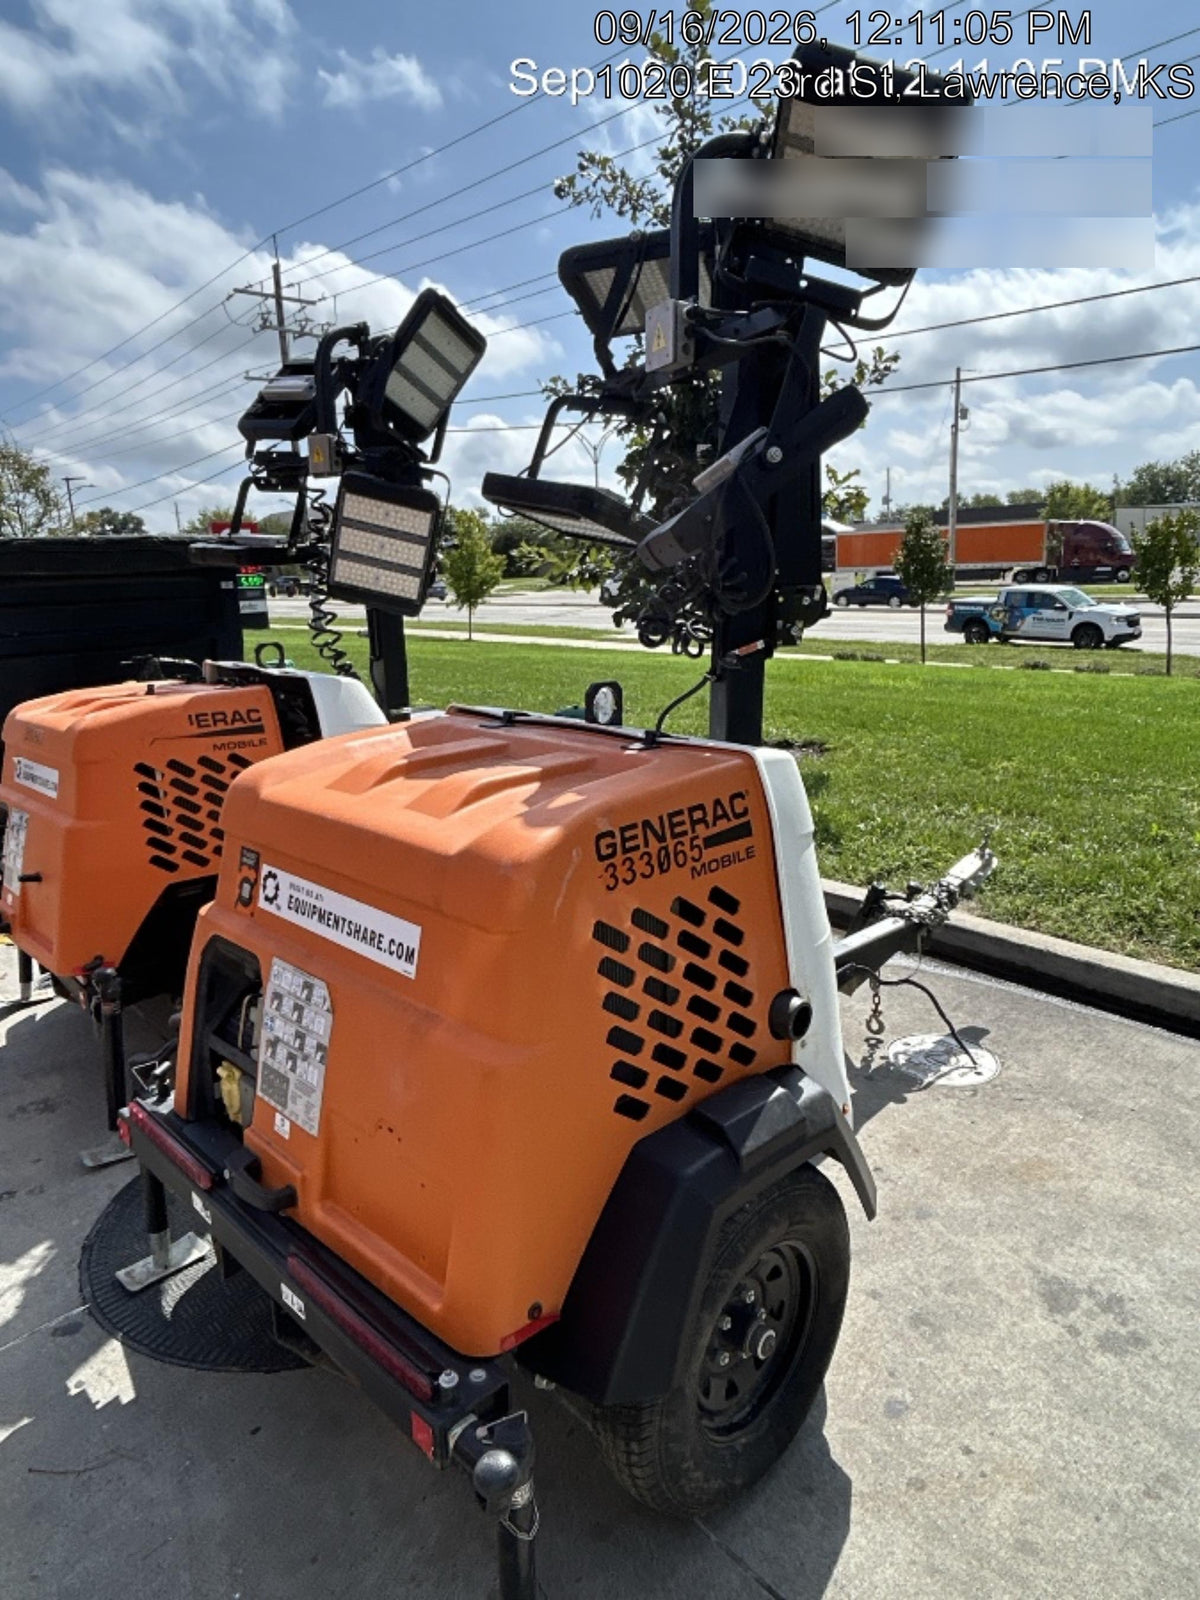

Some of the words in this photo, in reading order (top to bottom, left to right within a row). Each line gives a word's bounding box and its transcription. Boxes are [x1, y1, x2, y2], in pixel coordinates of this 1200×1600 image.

[213, 737, 267, 752] MOBILE
[594, 791, 749, 862] GENERAC
[604, 835, 704, 892] 333065
[690, 845, 756, 880] MOBILE
[287, 894, 416, 966] EQUIPMENTSHARE.COM
